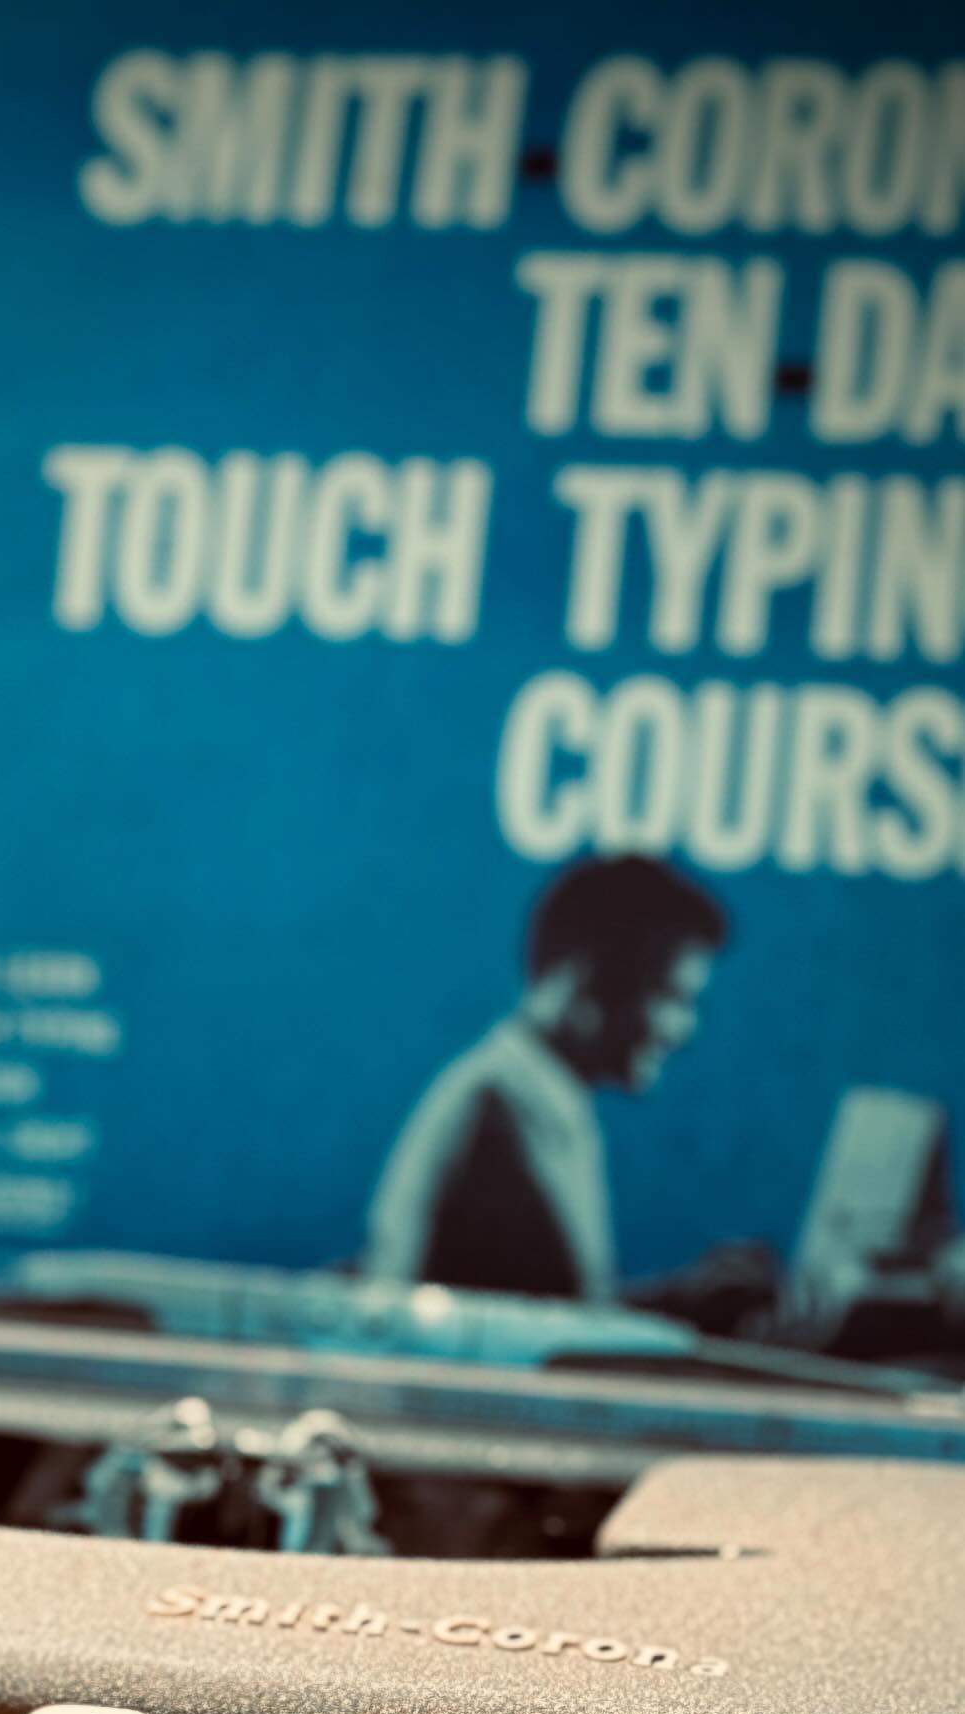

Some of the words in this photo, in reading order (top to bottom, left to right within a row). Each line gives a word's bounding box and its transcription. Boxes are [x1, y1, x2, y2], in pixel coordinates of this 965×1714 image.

[43, 444, 492, 645] TOUCH
[554, 464, 965, 664] TYPIN
[147, 1585, 729, 1677] Smith-Corona
